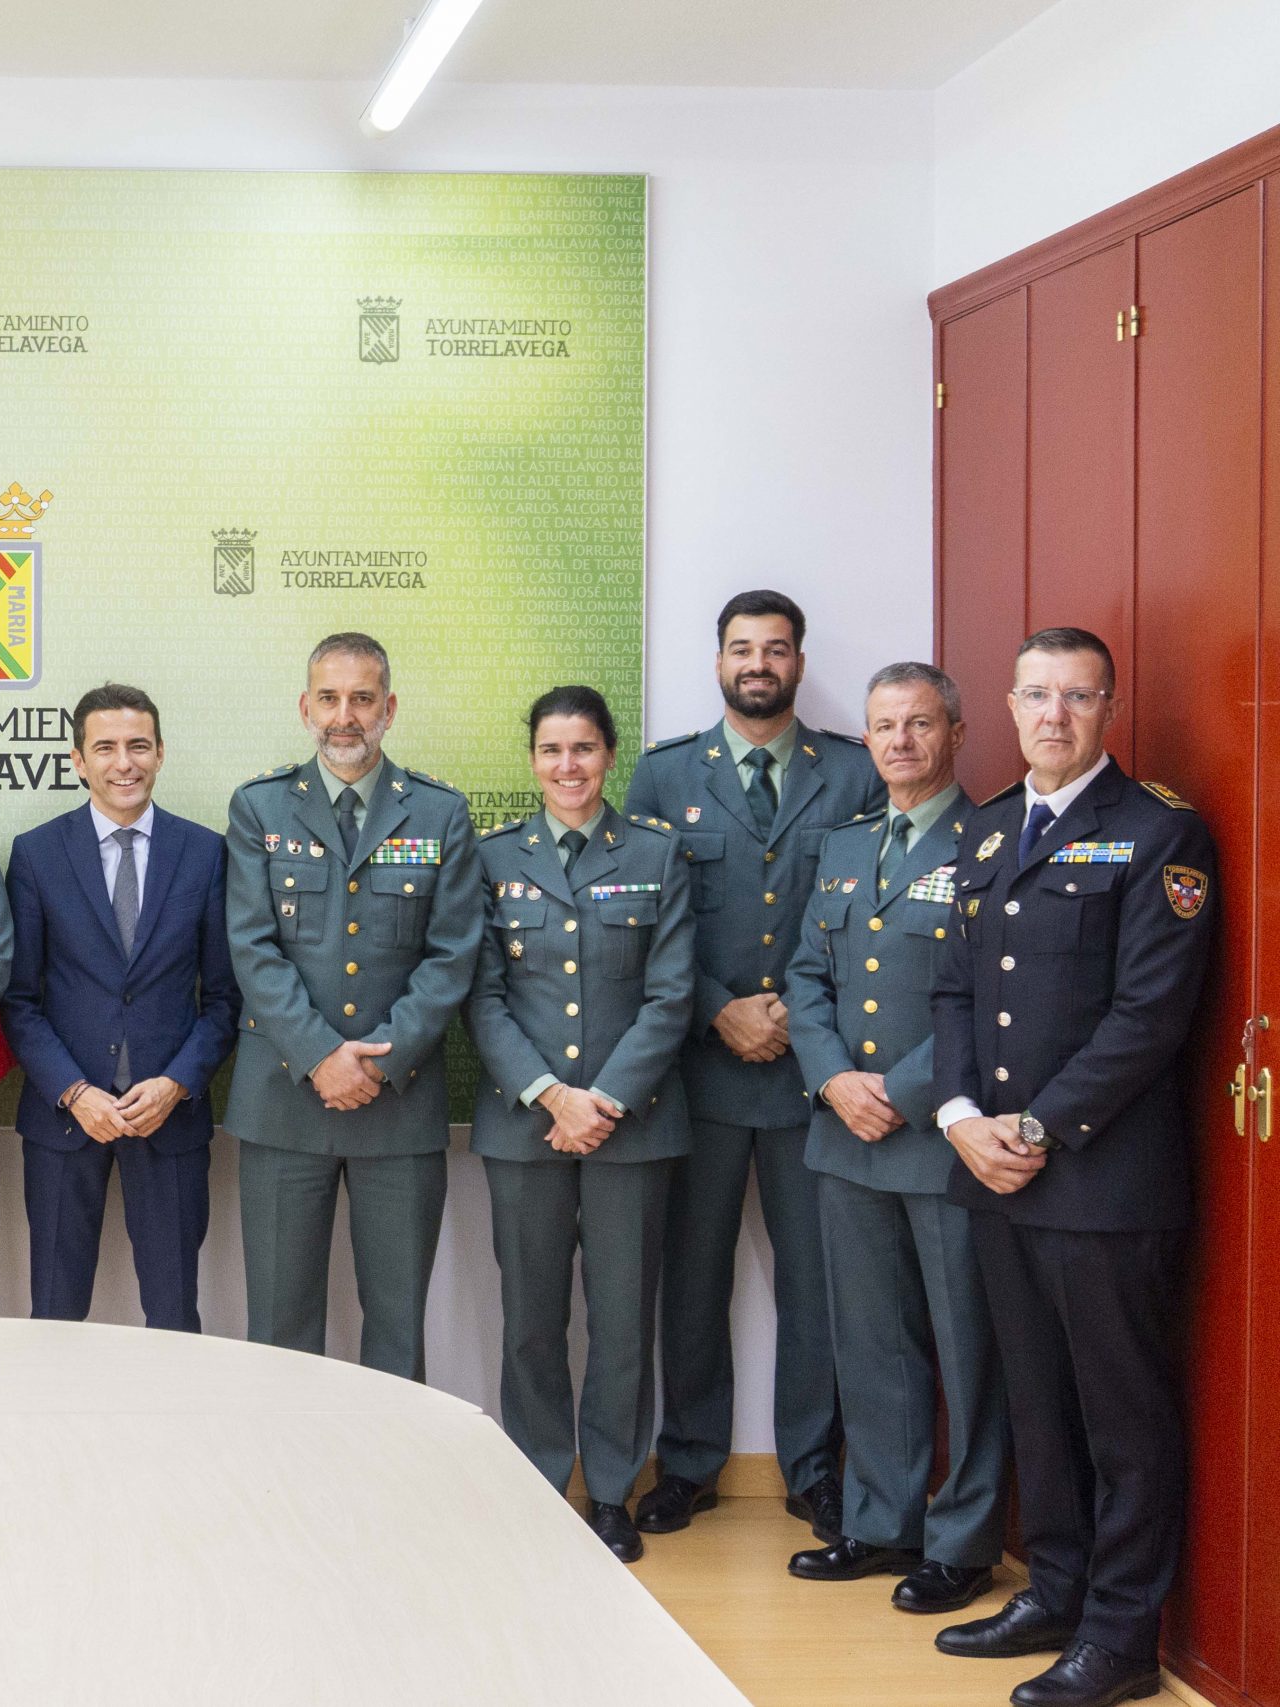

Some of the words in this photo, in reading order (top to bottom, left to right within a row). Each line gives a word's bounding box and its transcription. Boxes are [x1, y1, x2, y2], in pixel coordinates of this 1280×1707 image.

[507, 181, 563, 194] MANUEL
[568, 180, 638, 195] GUTIÉRREZ
[539, 195, 602, 208] SEVERINO
[519, 209, 607, 222] BARRENDERO
[547, 223, 617, 236] TEODOSIO
[464, 237, 528, 250] FEDERICO
[534, 237, 600, 250] MALLAVIA
[480, 250, 505, 263] DEL
[510, 251, 599, 264] BALONCESTO
[449, 264, 514, 277] COLLADO
[520, 265, 556, 278] SOTO
[561, 265, 603, 278] NOBEL
[548, 279, 582, 292] CLUB
[548, 293, 591, 306] PEDRO
[426, 319, 571, 335] AYUNTAMIENTO
[427, 340, 570, 357] TORRELAVEGA
[493, 404, 539, 417] OTERO
[544, 404, 589, 417] GRUPO
[595, 405, 611, 418] DE
[519, 418, 576, 431] IGNACIO
[581, 418, 627, 431] PARDO
[529, 432, 545, 445] LA
[550, 430, 619, 445] MONTAÑA
[470, 446, 525, 459] VICENTE
[531, 446, 580, 459] TRUEBA
[585, 447, 620, 460] JULIO
[520, 460, 614, 473] CASTELLANOS
[501, 474, 561, 487] ALCALDE
[567, 474, 591, 487] DEL
[490, 488, 553, 501] VOLEIBOL
[506, 502, 558, 515] CARLOS
[564, 502, 626, 515] ALCORTA
[533, 516, 549, 529] DE
[555, 516, 608, 529] DANZAS
[487, 530, 530, 543] NUEVA
[536, 530, 588, 543] CIUDAD
[487, 543, 543, 556] GRANDE
[547, 544, 561, 557] ES
[281, 550, 428, 567] AYUNTAMIENTO
[451, 558, 517, 571] MALLAVIA
[522, 558, 567, 571] CORAL
[573, 558, 590, 571] DE
[282, 571, 427, 589] TORRELAVEGA
[529, 572, 592, 585] CASTILLO
[597, 572, 635, 585] ARCO
[572, 584, 601, 599] JOSÉ
[606, 586, 634, 599] LUIS
[8, 585, 26, 648] MARIA
[467, 613, 510, 626] PEDRO
[515, 613, 579, 626] SOBRADO
[544, 627, 605, 640] ALFONSO
[489, 641, 505, 654] DE
[510, 641, 580, 654] MUESTRAS
[505, 655, 559, 668] MANUEL
[565, 653, 636, 668] GUTIÉRREZ
